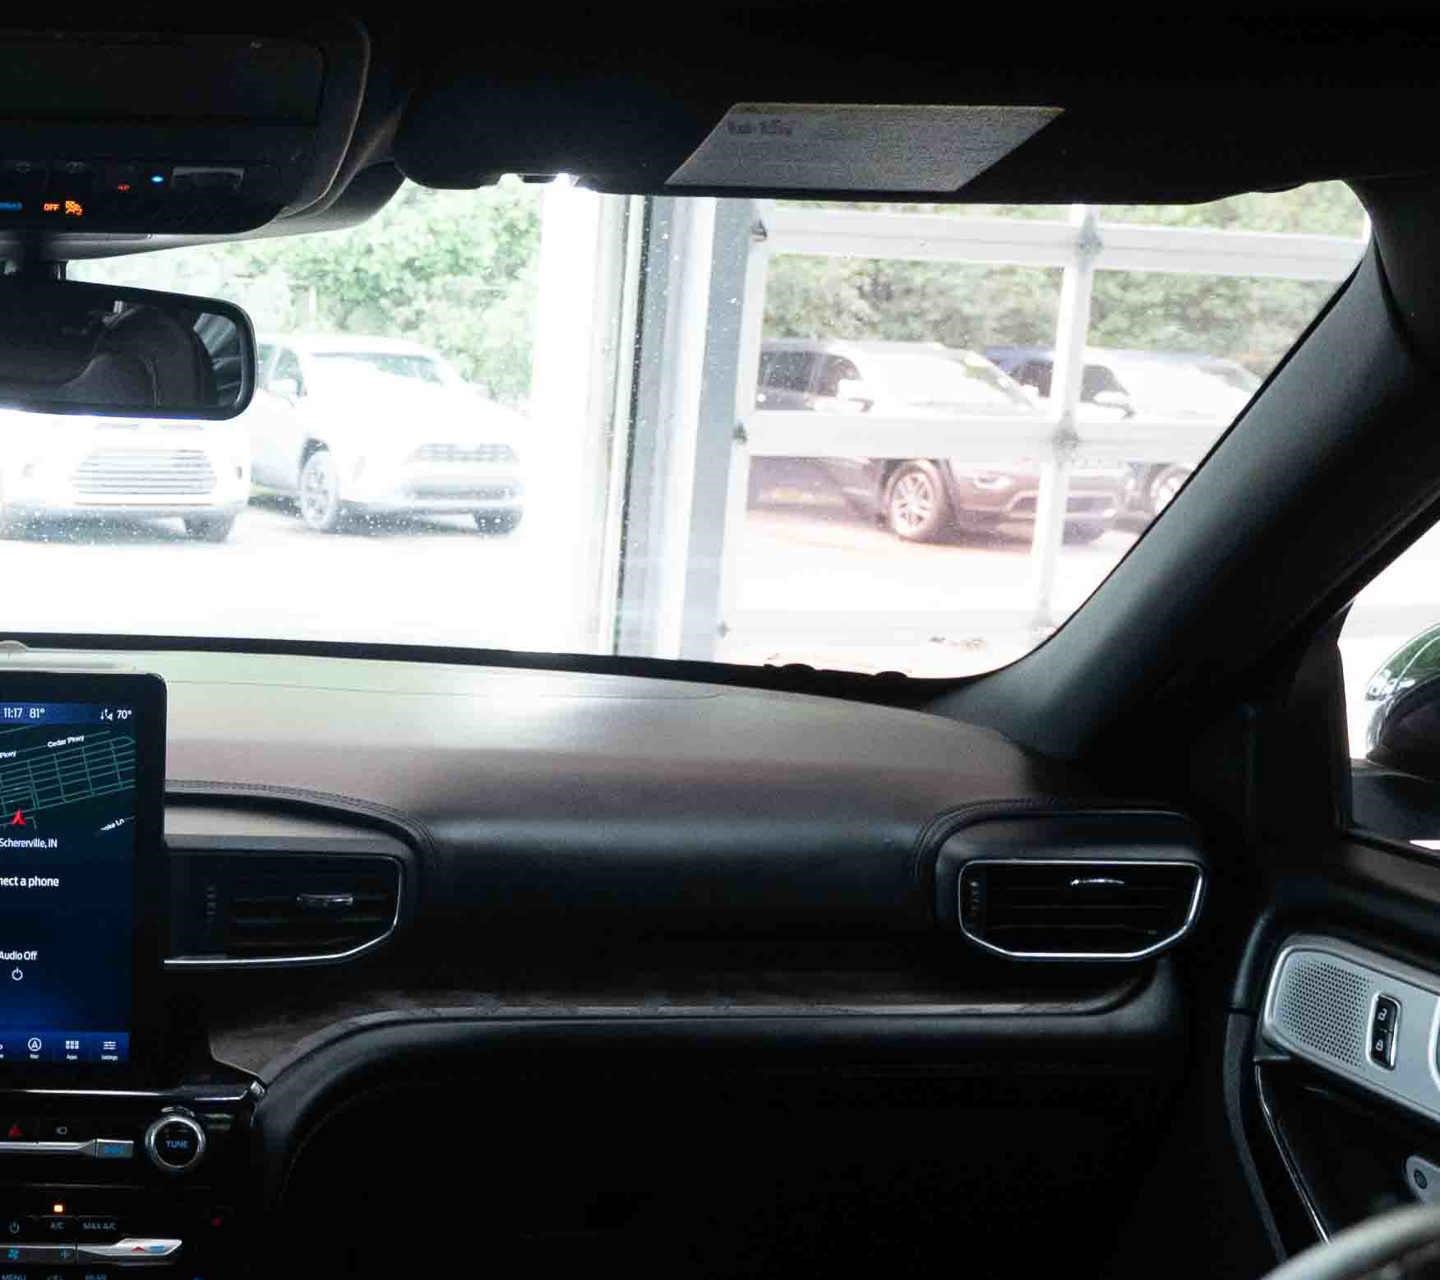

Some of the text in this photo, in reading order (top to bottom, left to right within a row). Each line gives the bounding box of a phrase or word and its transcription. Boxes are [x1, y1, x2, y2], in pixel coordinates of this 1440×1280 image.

[43, 203, 61, 213] OFF
[3, 707, 45, 719] 11:17 81°
[116, 709, 132, 720] 70°
[48, 838, 58, 848] IN
[20, 877, 27, 887] a
[28, 875, 60, 889] phone
[23, 950, 39, 960] Off
[165, 1139, 189, 1150] TUNE
